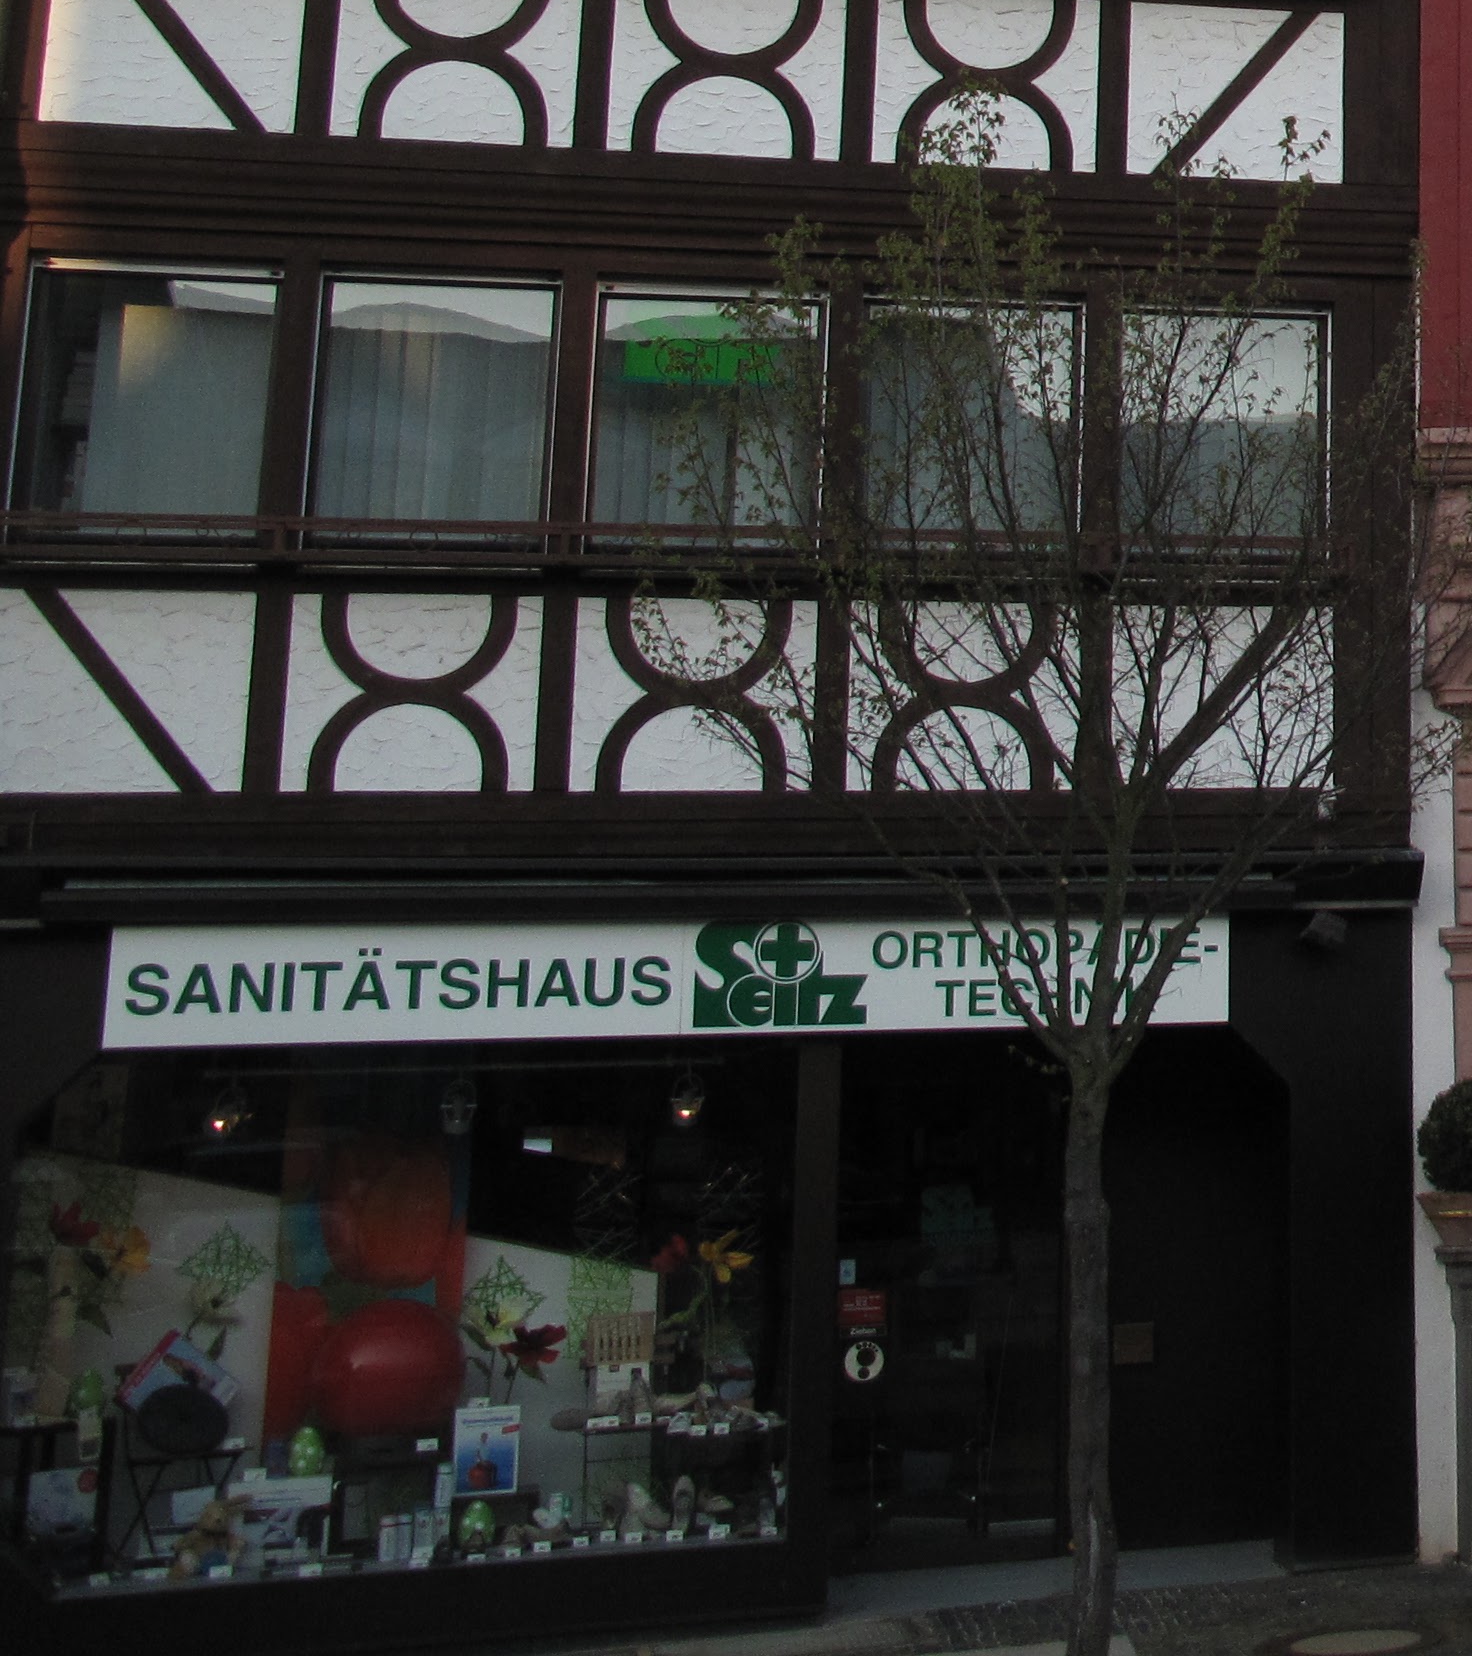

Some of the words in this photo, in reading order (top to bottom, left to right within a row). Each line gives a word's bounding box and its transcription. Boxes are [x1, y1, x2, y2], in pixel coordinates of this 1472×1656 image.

[124, 947, 672, 1017] SANITÄTSHAUS
[692, 919, 868, 1028] Seitz
[934, 976, 1156, 1017] TECN
